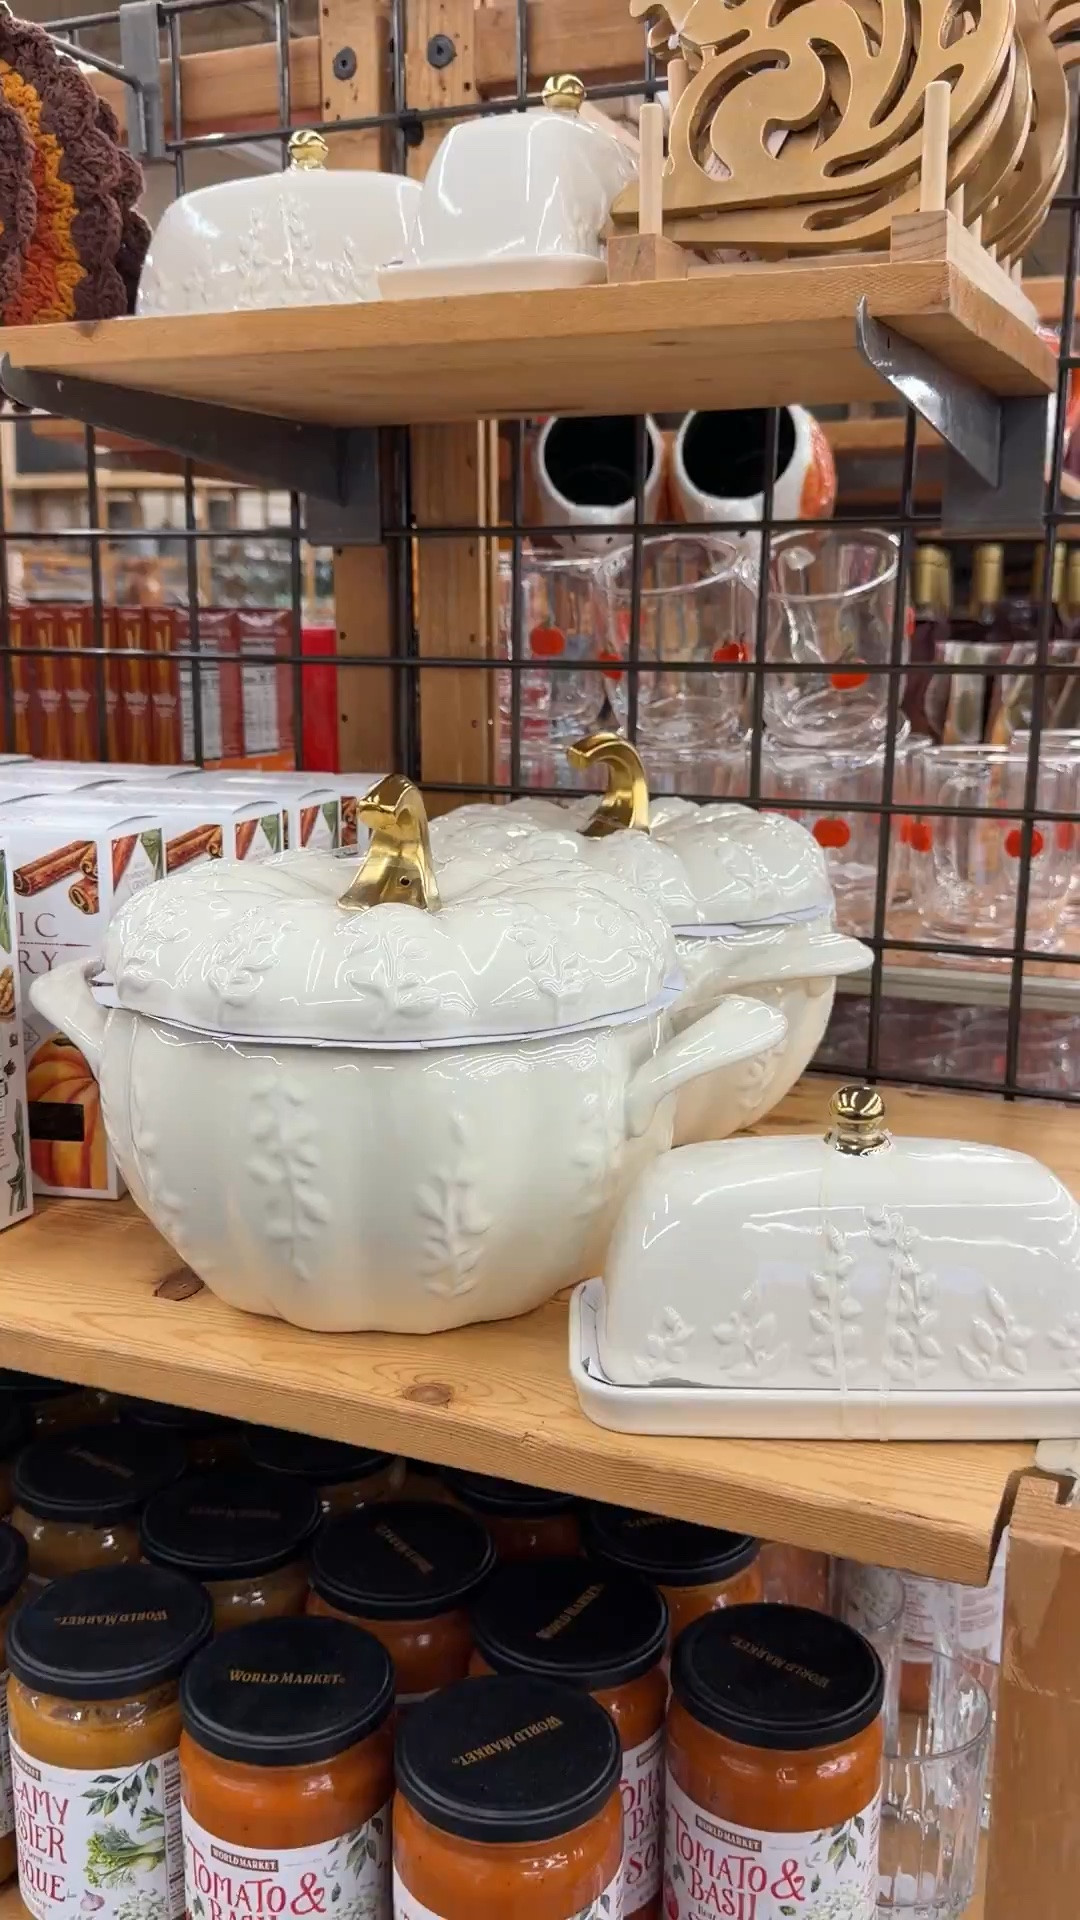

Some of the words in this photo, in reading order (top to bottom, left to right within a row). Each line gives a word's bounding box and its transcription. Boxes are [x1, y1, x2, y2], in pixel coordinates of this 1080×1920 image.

[229, 1668, 279, 1683] WORLD
[187, 1836, 287, 1914] TOMATO
[290, 1872, 326, 1915] &
[671, 1803, 767, 1892] TOMATO
[771, 1859, 805, 1901] &
